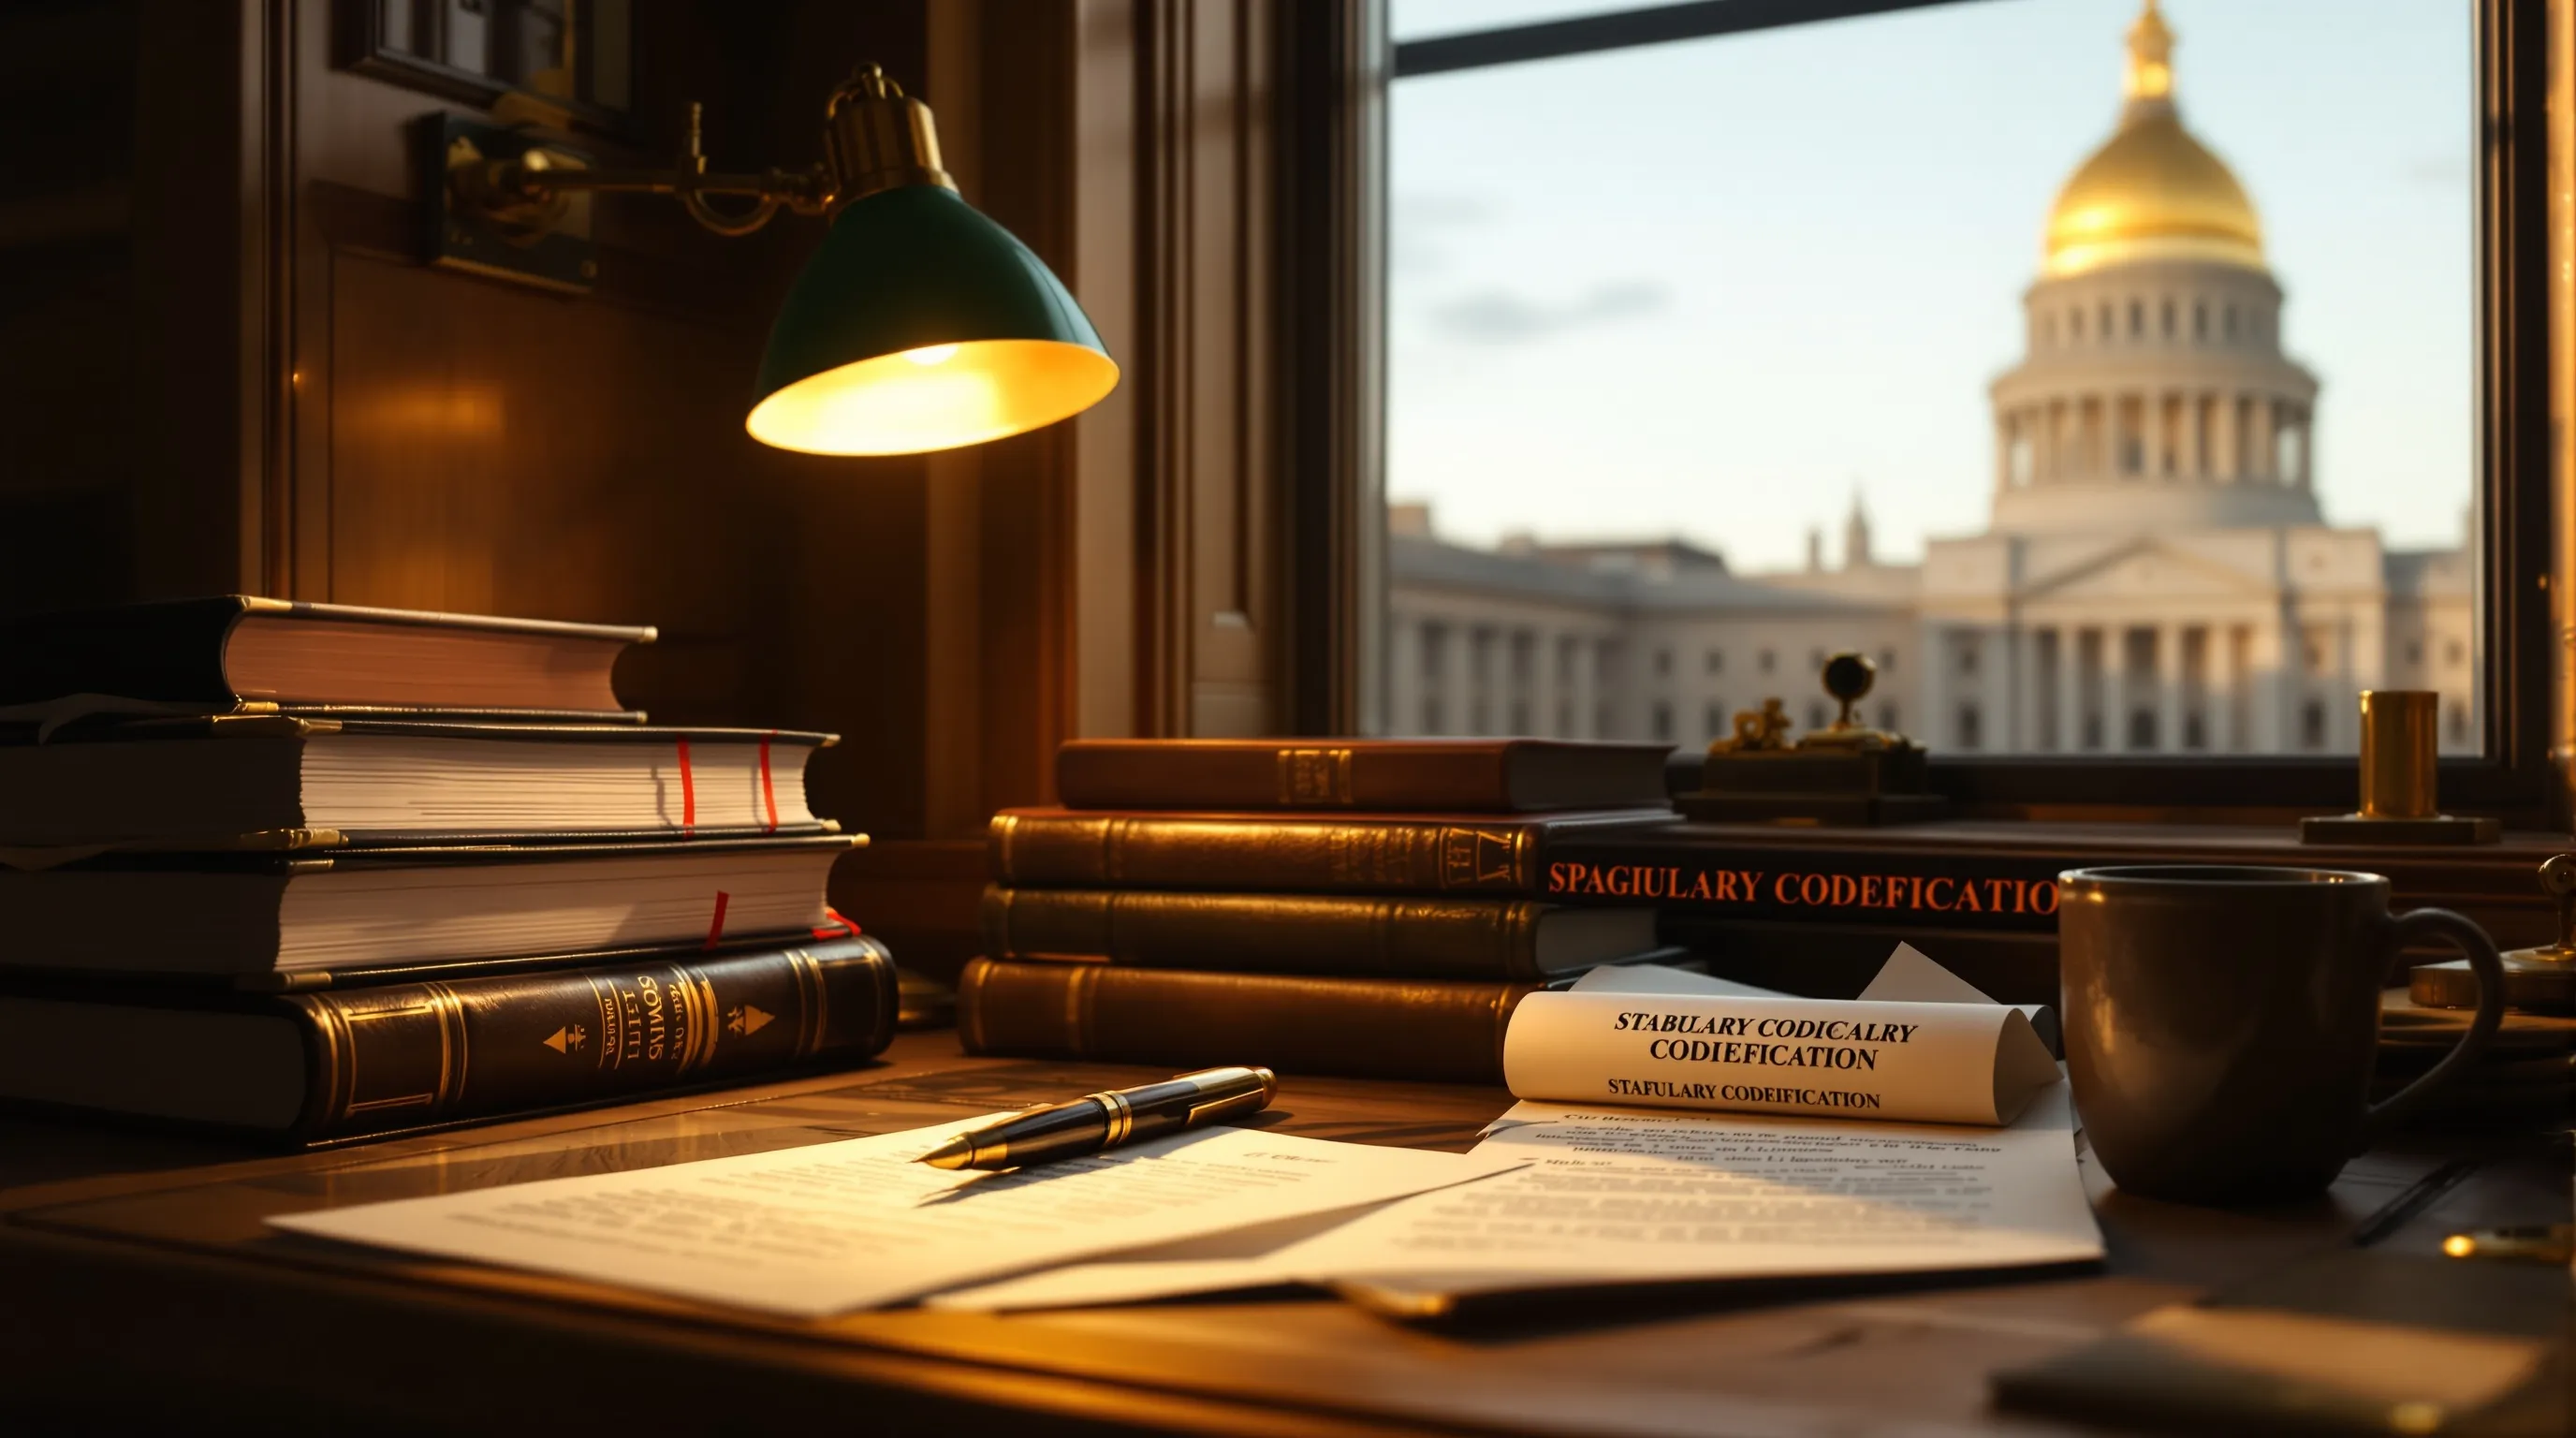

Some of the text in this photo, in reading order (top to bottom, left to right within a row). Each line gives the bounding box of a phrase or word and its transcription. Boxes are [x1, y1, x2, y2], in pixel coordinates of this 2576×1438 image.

[1548, 861, 1764, 902] SPAGIULARY
[1614, 1011, 1919, 1045] STABULARY CODICALRY
[1648, 1037, 1880, 1071] CODIEFICATION
